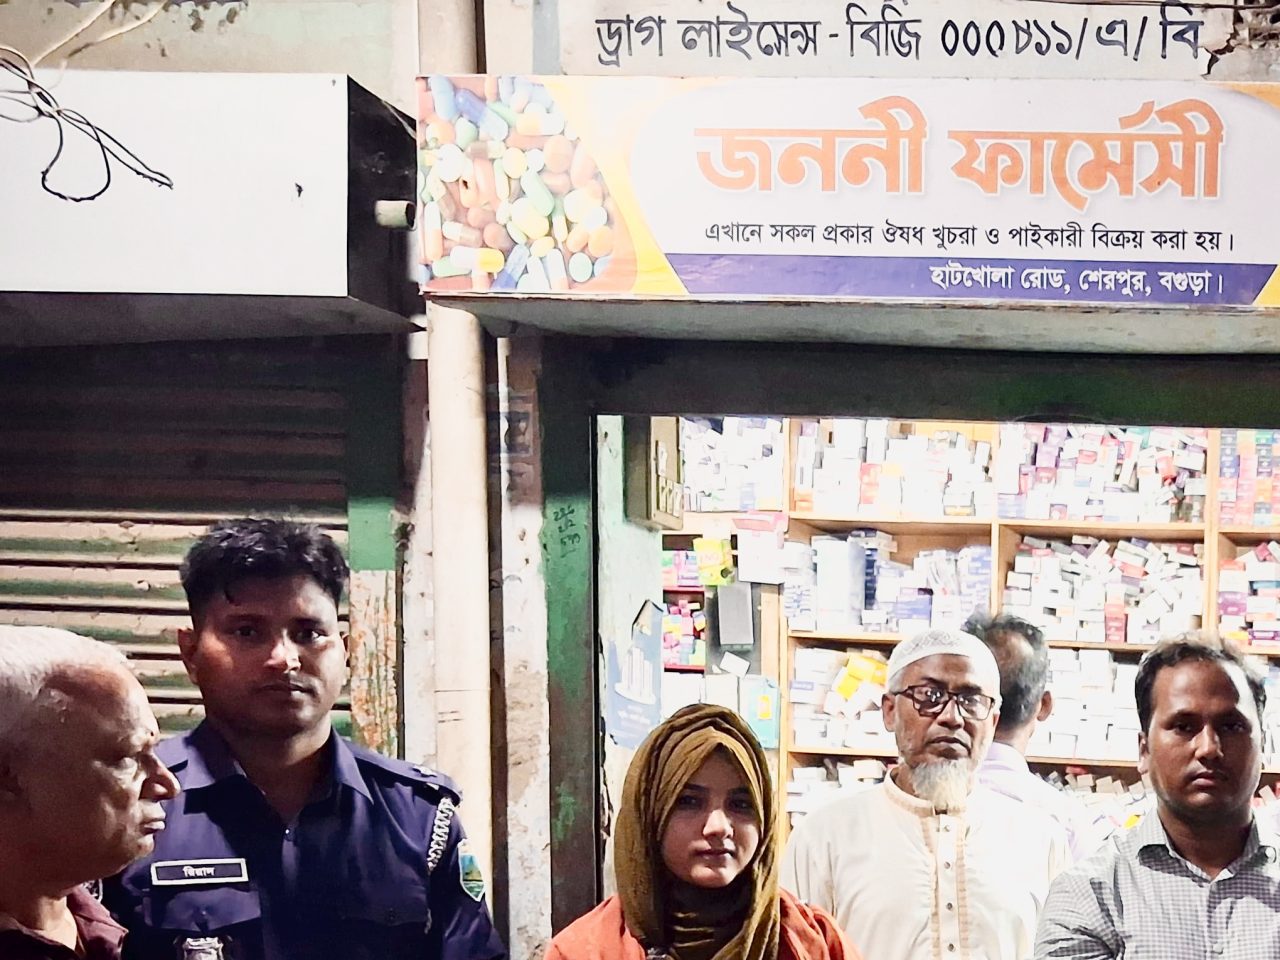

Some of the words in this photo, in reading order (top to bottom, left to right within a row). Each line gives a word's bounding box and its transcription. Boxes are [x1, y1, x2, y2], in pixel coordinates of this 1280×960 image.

[595, 14, 666, 67] ড্রাগ
[677, 1, 821, 60] লাইসেন্স
[846, 3, 922, 60] বিজি
[694, 95, 928, 194] জননী
[948, 98, 1225, 212] ফার্মেসী
[705, 221, 763, 243] এখানে
[770, 223, 816, 243] সকল
[823, 222, 874, 244] প্রকার
[882, 218, 925, 245] ঔষধ
[932, 225, 977, 250] খুচরা
[985, 228, 1000, 244] ও
[1008, 221, 1085, 249] পাইকারী
[1091, 223, 1145, 249] বিক্রয়
[1151, 229, 1188, 250] করা
[929, 260, 1014, 290] হাটখোলা
[1021, 267, 1071, 295] রোড,
[1079, 268, 1152, 297] শেরপুর,
